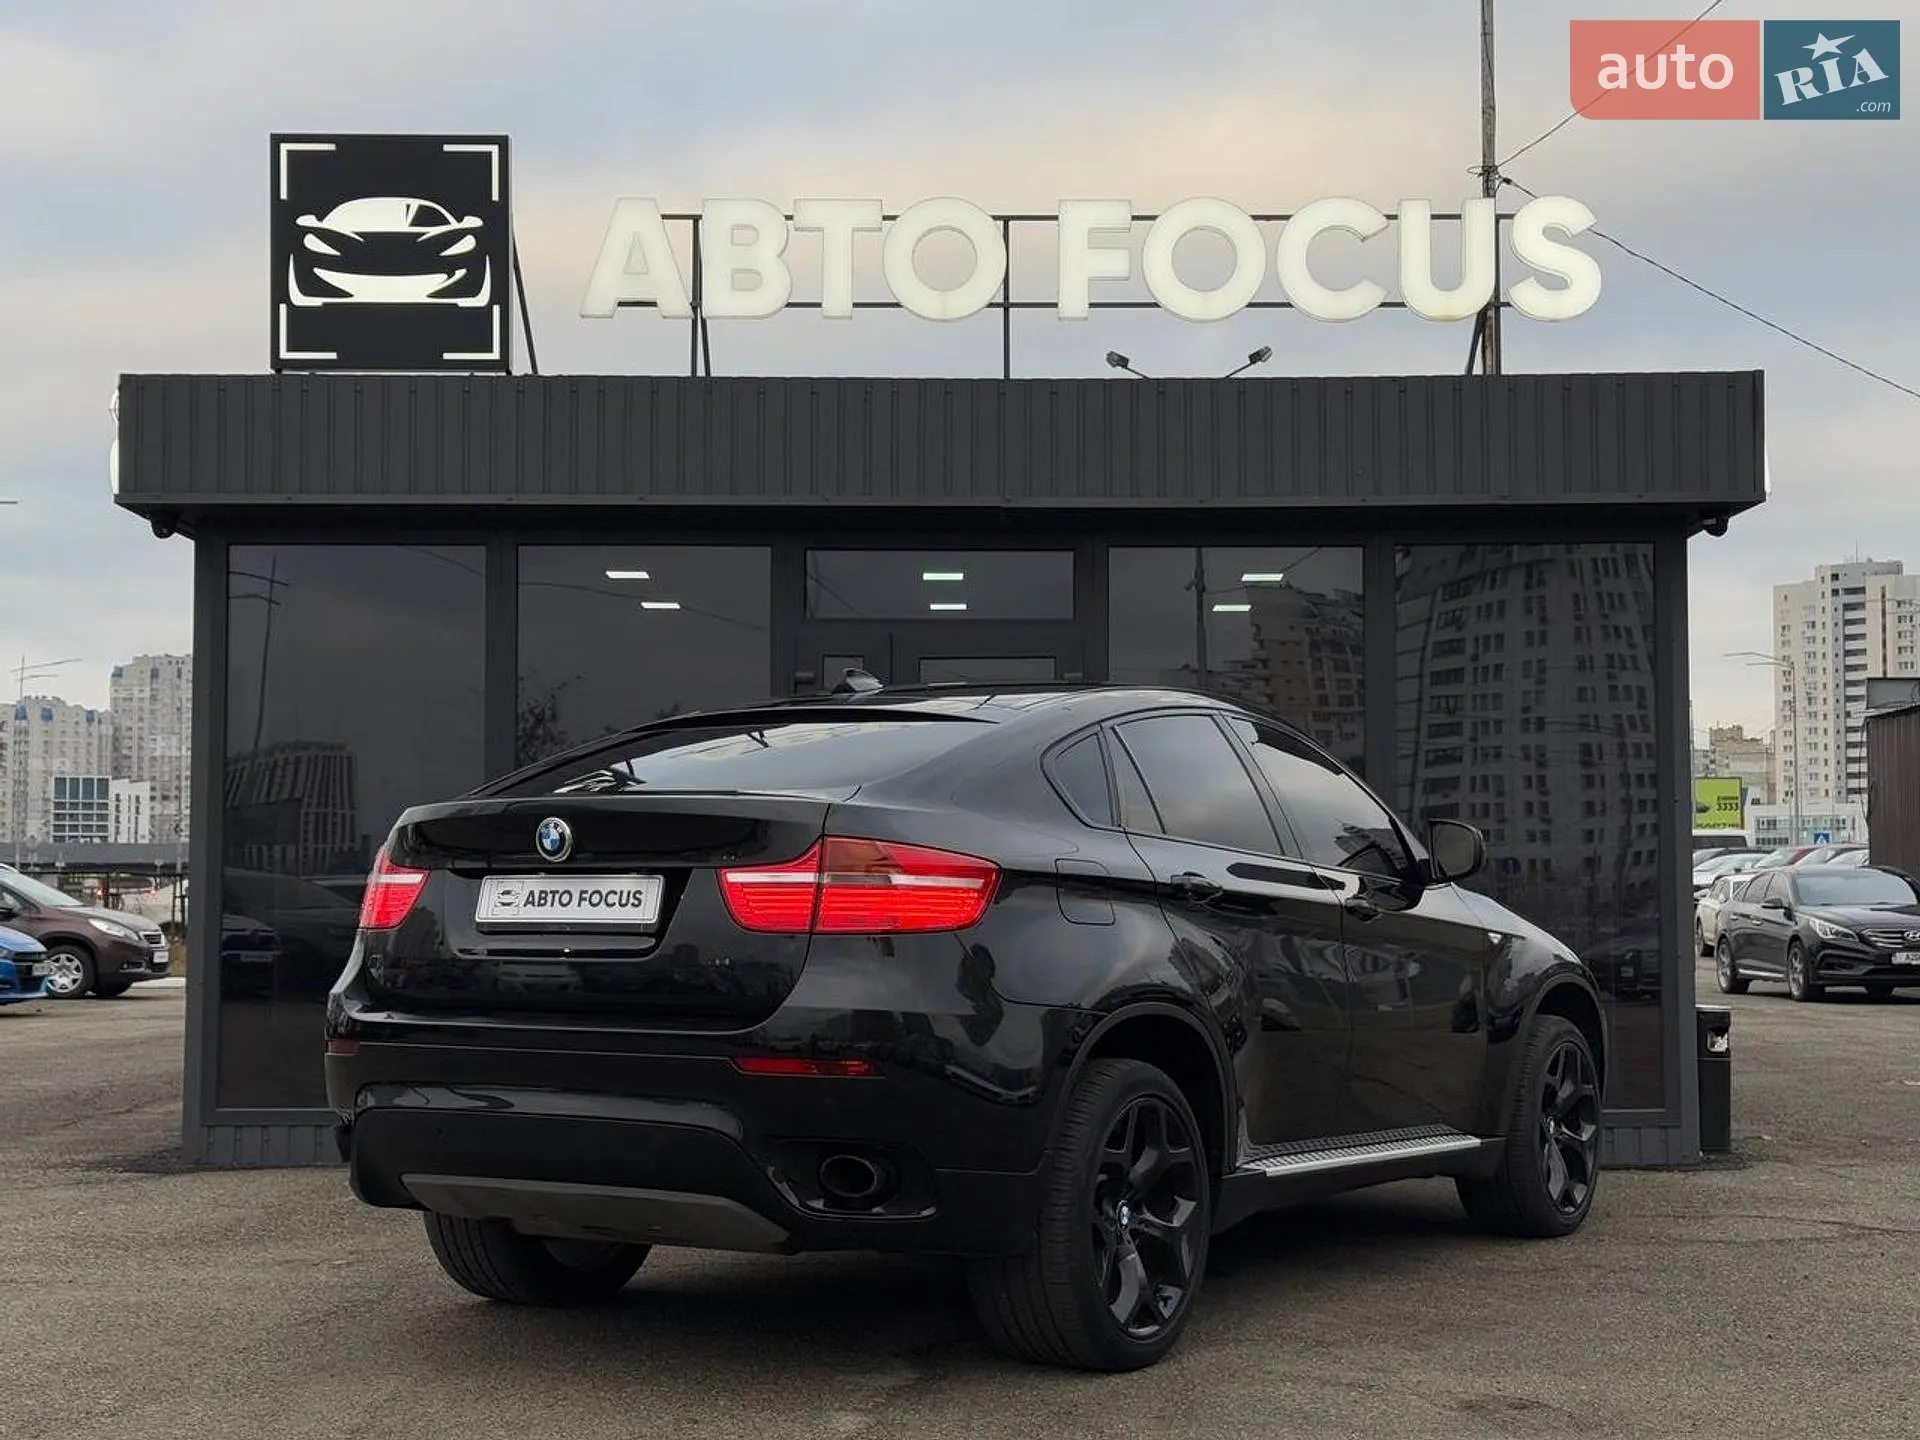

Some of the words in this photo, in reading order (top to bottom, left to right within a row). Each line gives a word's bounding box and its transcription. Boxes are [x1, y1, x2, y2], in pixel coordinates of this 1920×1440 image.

[579, 197, 1007, 322] АВТО
[1058, 196, 1602, 322] FOCUS
[523, 889, 573, 909] АВТО
[577, 889, 643, 909] FOCUS
